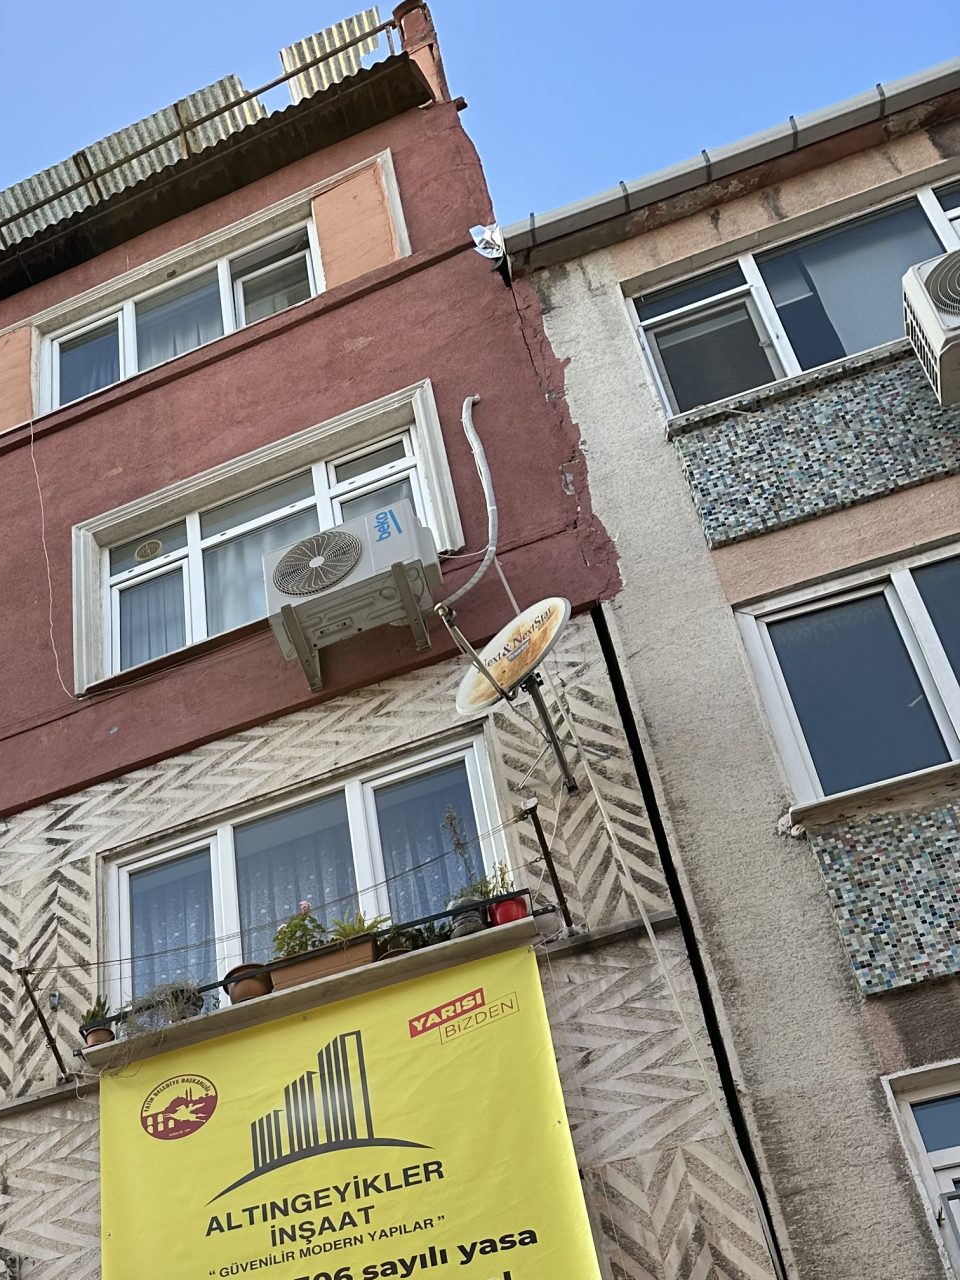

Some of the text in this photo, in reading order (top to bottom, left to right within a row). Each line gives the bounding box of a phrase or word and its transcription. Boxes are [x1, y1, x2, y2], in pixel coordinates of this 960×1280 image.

[373, 511, 392, 542] beko
[411, 992, 483, 1031] YARISI
[206, 1161, 444, 1237] ALTINGEYİKLER
[219, 1251, 295, 1277] GÜVENİLİR
[299, 1235, 363, 1258] MODERN
[367, 1218, 434, 1241] YAPILAR
[271, 1205, 375, 1247] İNŞAAT
[362, 1246, 448, 1280] sayılı
[457, 1230, 538, 1265] yasa
